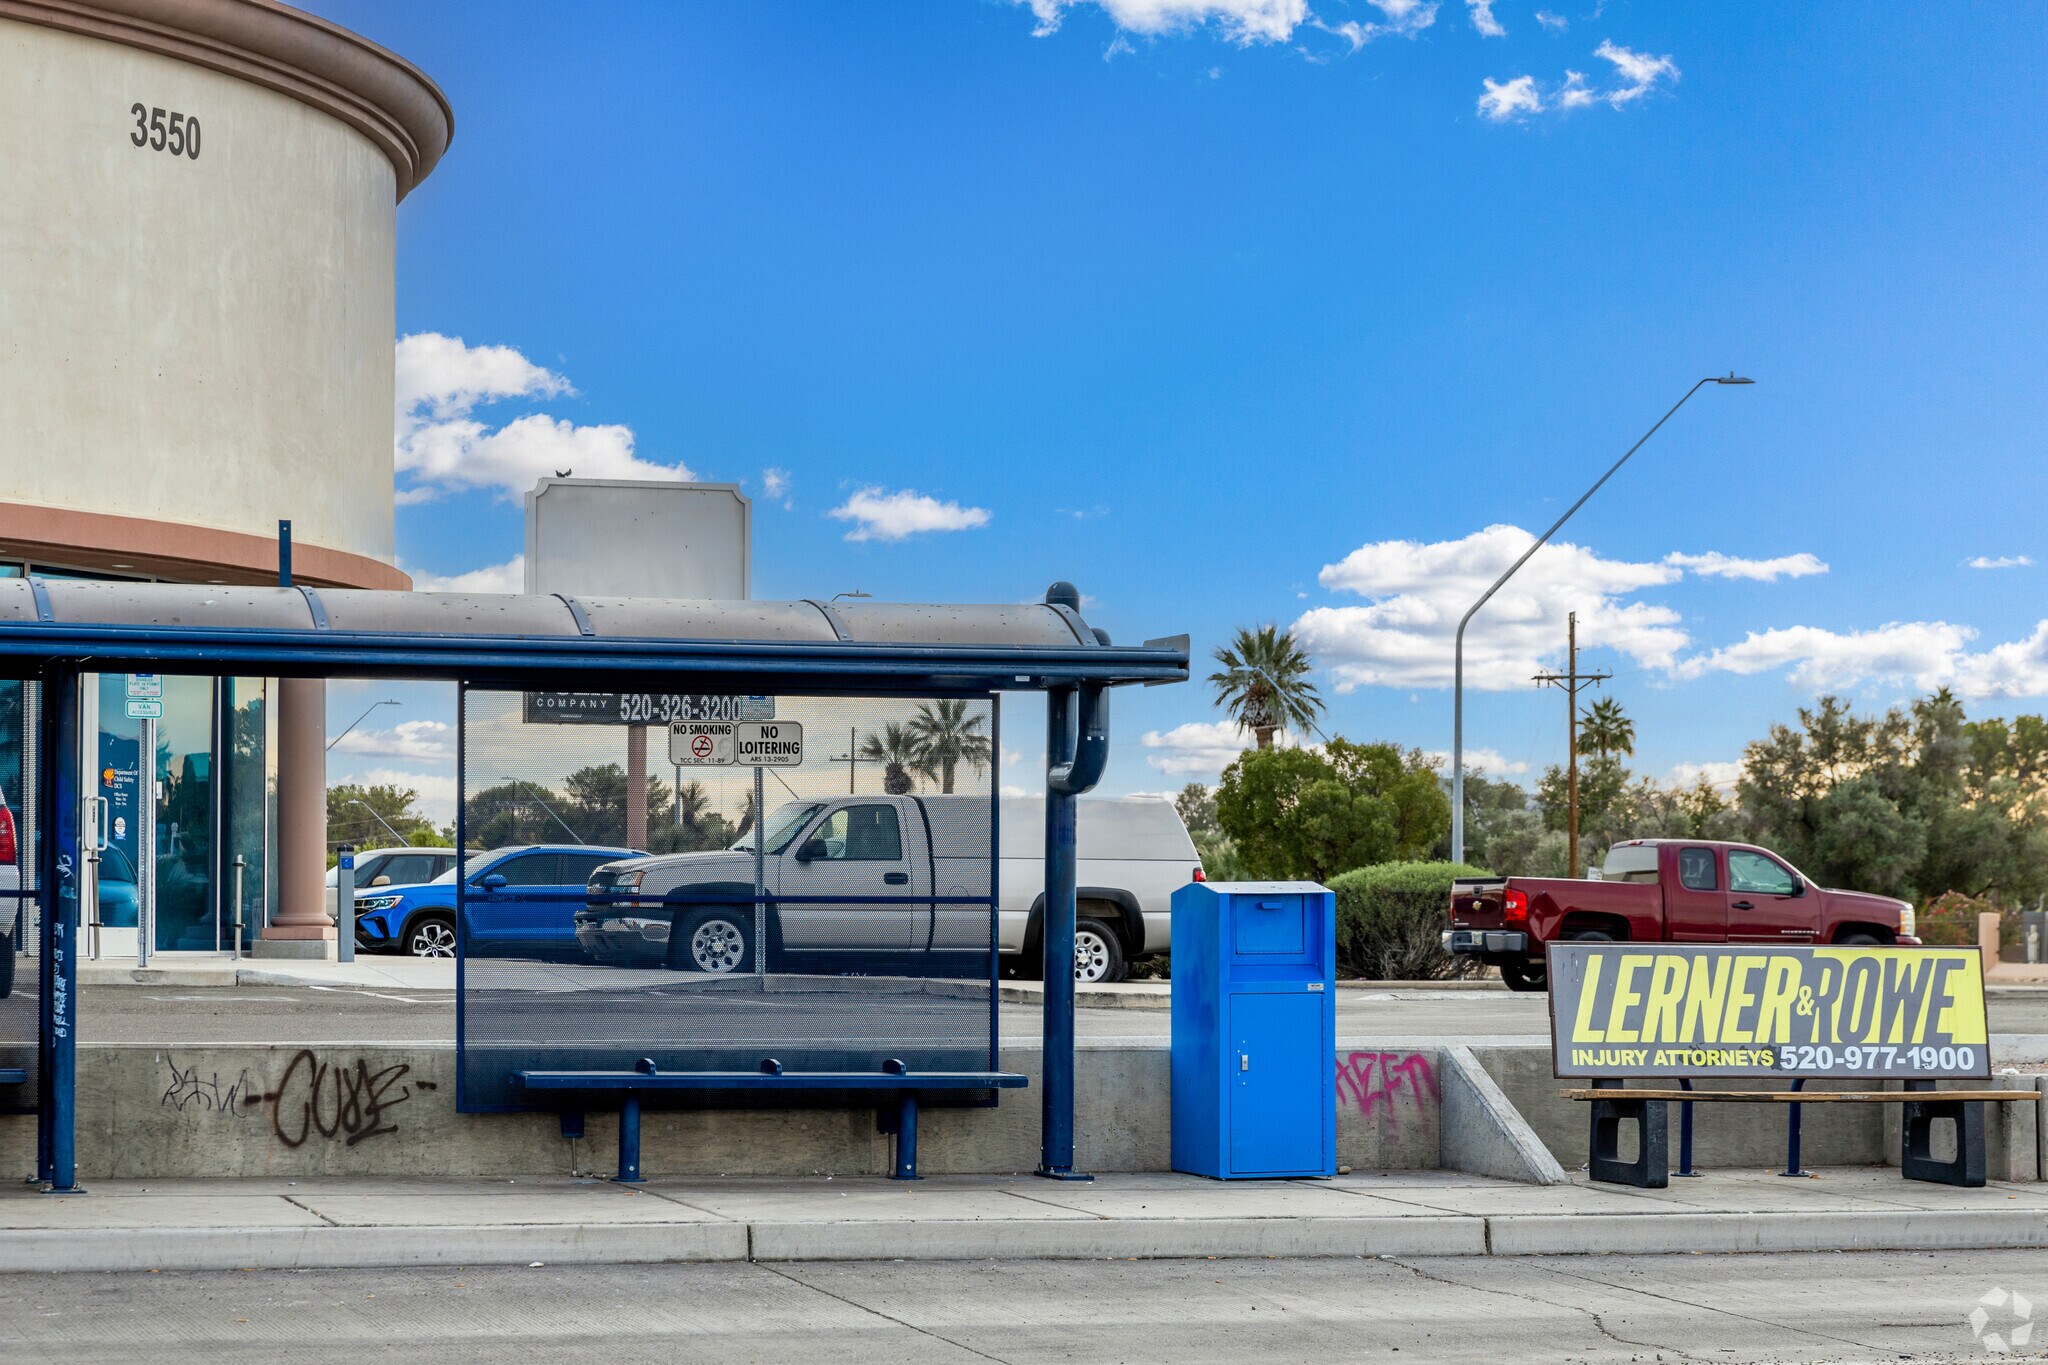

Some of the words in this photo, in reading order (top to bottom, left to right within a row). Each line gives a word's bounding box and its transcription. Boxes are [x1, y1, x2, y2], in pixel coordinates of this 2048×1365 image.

[130, 102, 201, 160] 3550
[536, 698, 608, 709] COMPANY
[620, 694, 741, 721] 520-326-3200
[673, 725, 687, 735] NO
[689, 725, 732, 735] SMOKING
[760, 726, 779, 739] NO
[739, 742, 800, 755] LOITERING
[1572, 954, 1803, 1044] LERNER
[1796, 985, 1815, 1016] &
[1809, 956, 1967, 1045] ROWE
[1572, 1049, 1649, 1067] INJURY
[1653, 1049, 1775, 1067] ATTORNEYS
[1779, 1046, 1975, 1071] 520-977-1900
